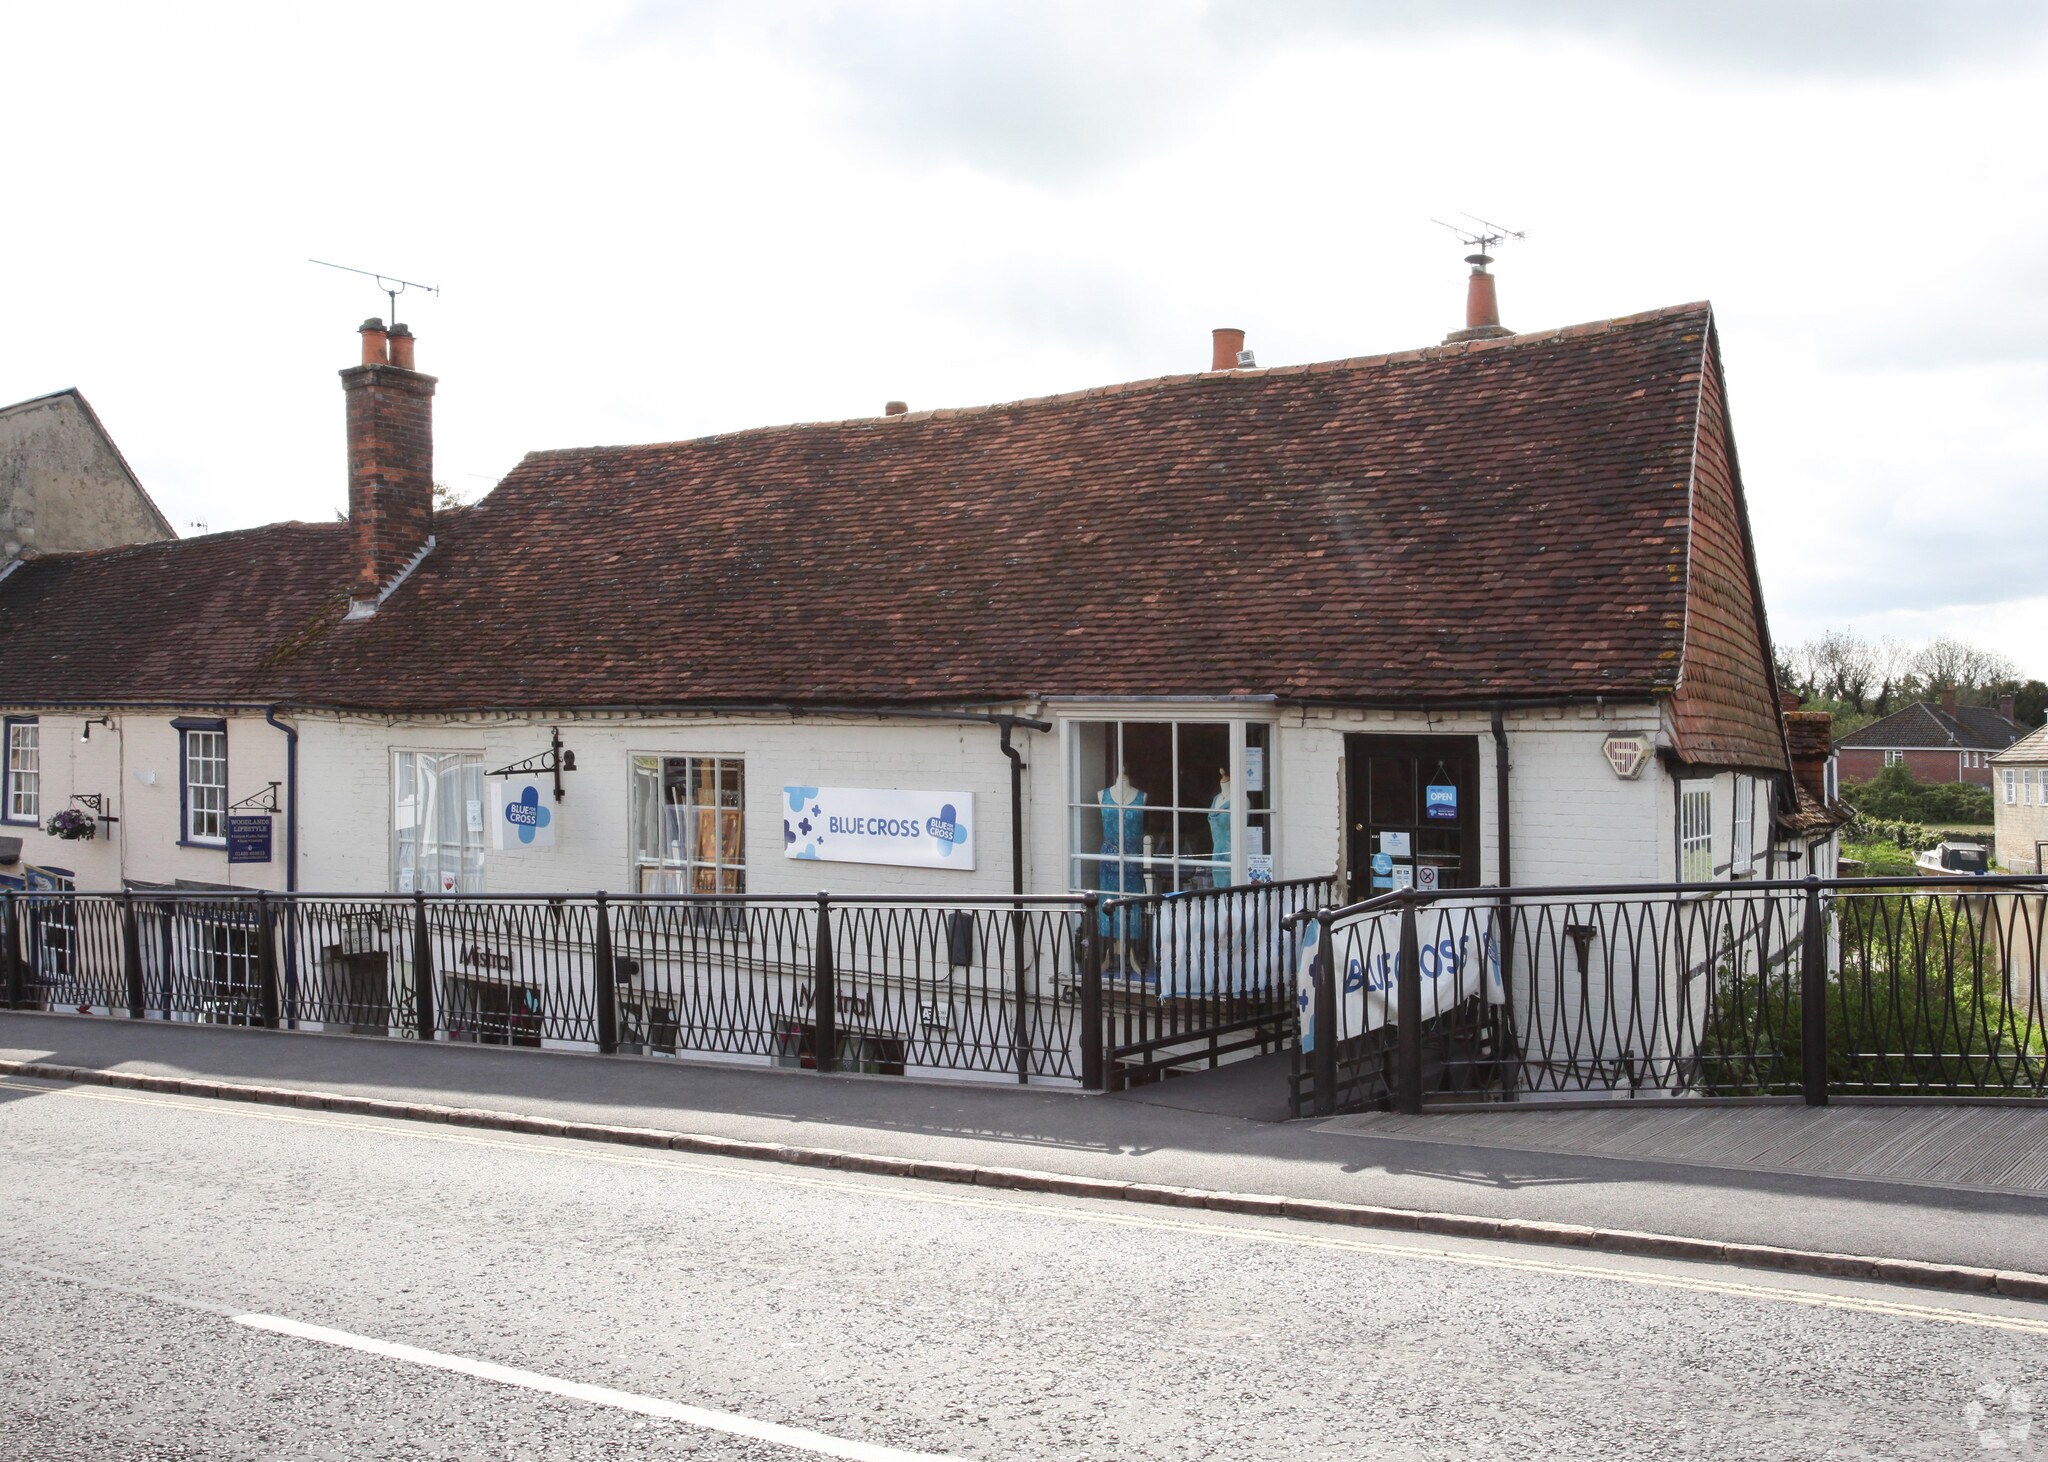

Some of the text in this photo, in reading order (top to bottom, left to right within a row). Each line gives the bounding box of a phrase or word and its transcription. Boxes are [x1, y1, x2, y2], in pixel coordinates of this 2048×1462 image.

[1430, 792, 1453, 801] OPEN
[511, 804, 529, 815] BLUE
[510, 813, 536, 825] CROSS
[931, 818, 948, 831] BLUE
[829, 816, 920, 838] BLUE CROSS
[929, 827, 954, 840] CROSS
[799, 982, 872, 1017] Mtral
